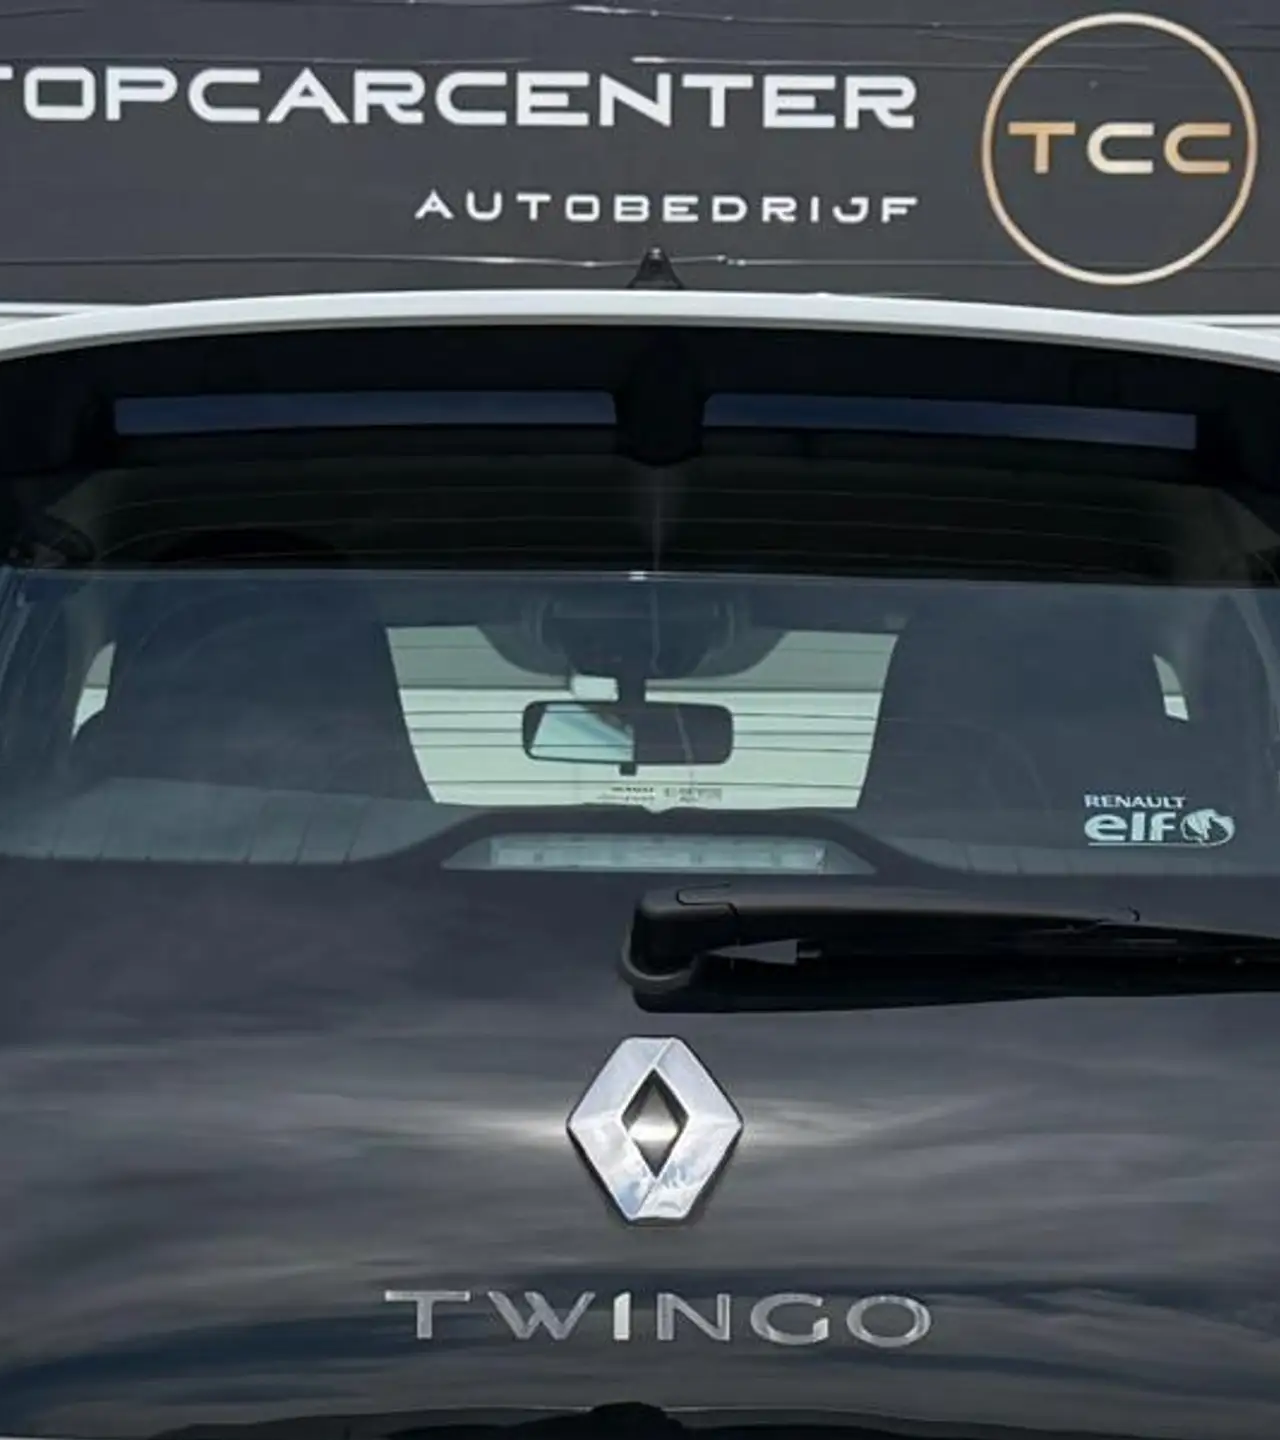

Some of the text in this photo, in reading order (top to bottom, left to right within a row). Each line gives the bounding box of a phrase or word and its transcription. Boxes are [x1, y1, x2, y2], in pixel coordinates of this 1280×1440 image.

[1007, 120, 1232, 176] TCC
[413, 191, 919, 225] AUTOBEDRIJF
[1083, 794, 1186, 809] RENAULT
[1083, 811, 1177, 842] elf
[383, 1289, 933, 1349] TWINGO
